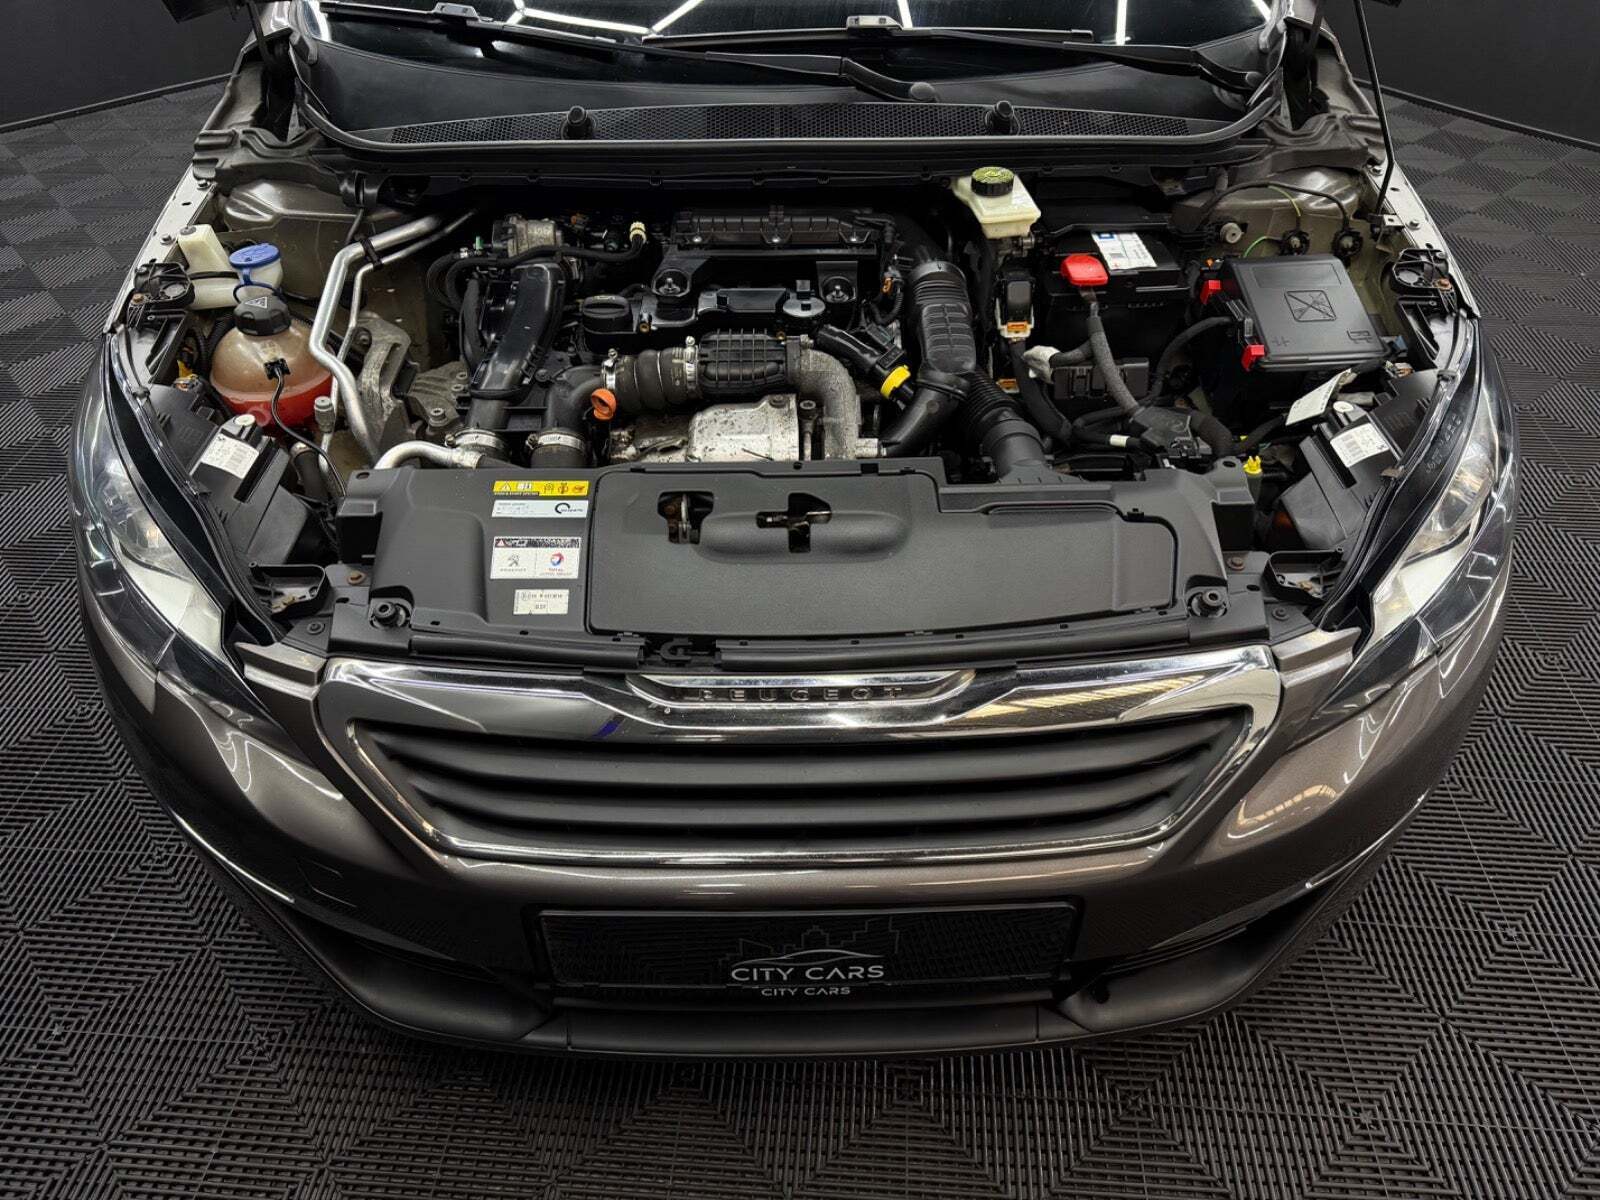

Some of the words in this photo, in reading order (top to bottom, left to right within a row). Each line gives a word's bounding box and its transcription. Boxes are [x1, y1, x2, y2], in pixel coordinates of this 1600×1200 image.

[698, 687, 903, 702] PEUGEOT
[731, 967, 794, 981] CITY
[805, 965, 884, 980] CARS
[761, 987, 798, 996] CITY
[804, 986, 851, 996] CARS
